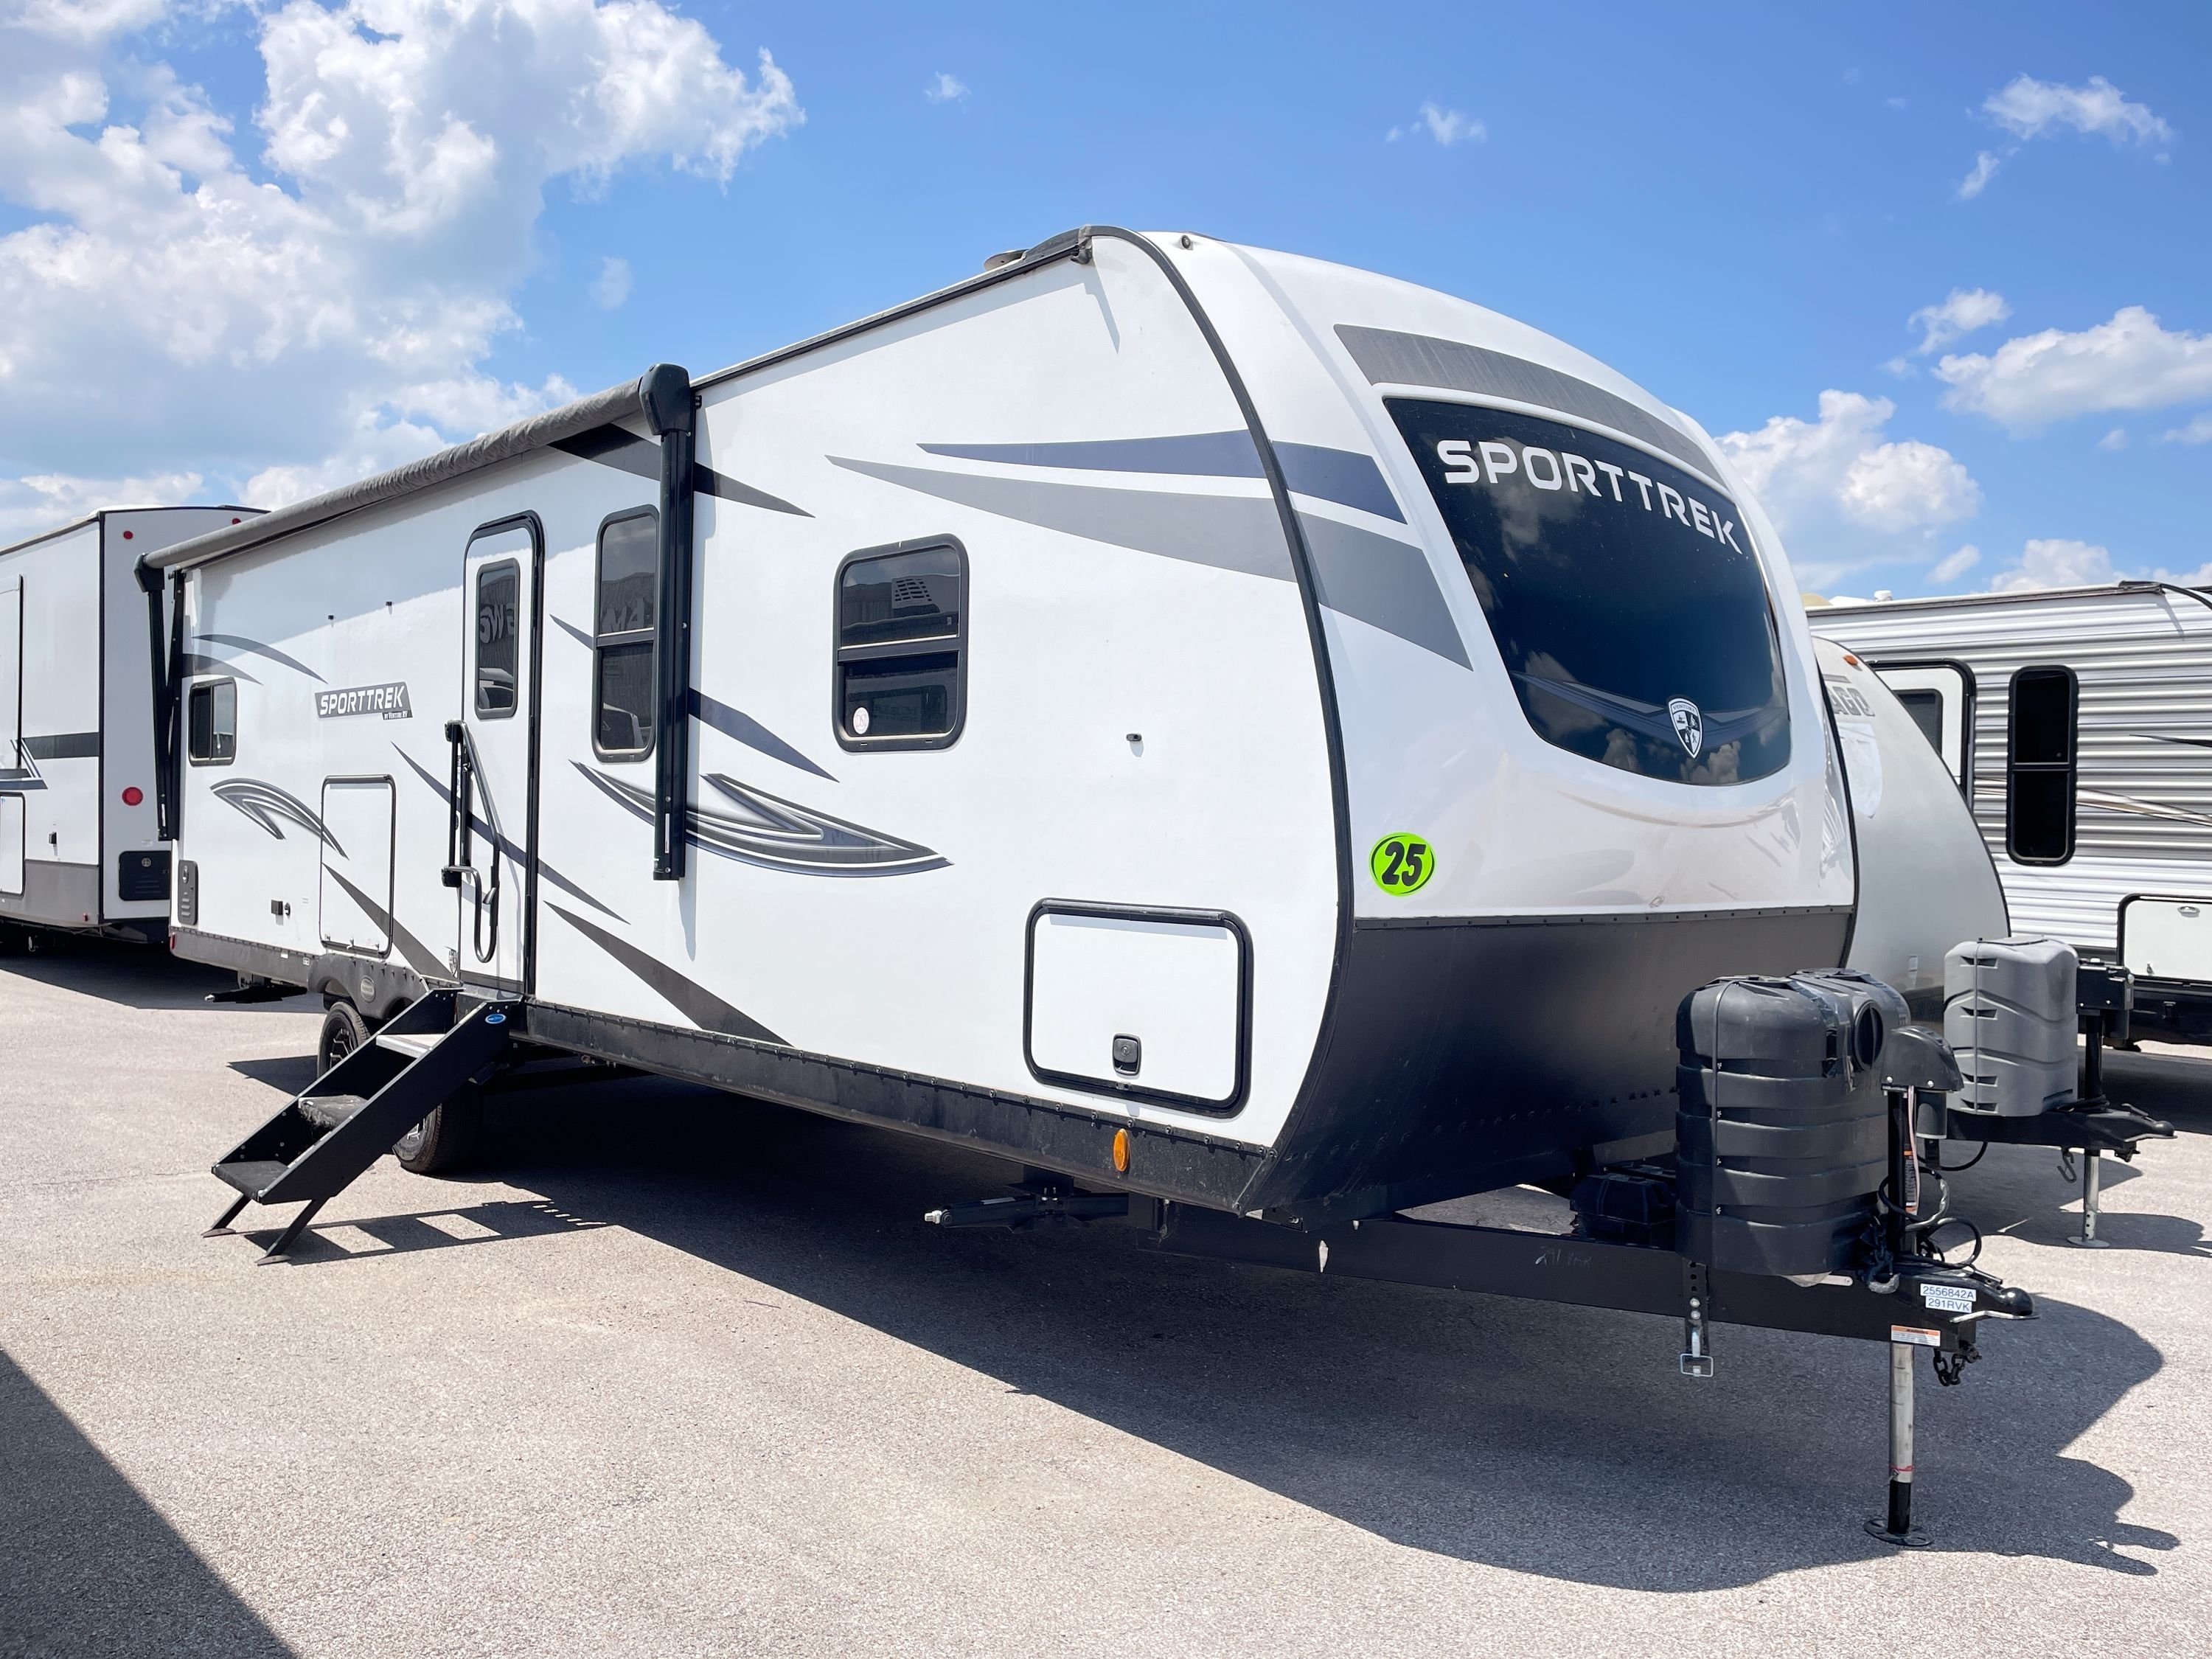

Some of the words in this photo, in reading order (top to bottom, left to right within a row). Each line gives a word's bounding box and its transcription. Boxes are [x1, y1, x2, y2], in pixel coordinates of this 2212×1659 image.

[1437, 439, 1743, 554] SPORTTREK
[320, 685, 405, 715] SPORTTREK
[1382, 841, 1426, 886] 25
[1923, 1286, 1975, 1300] 2556842A
[1928, 1298, 1970, 1311] 291RVK
